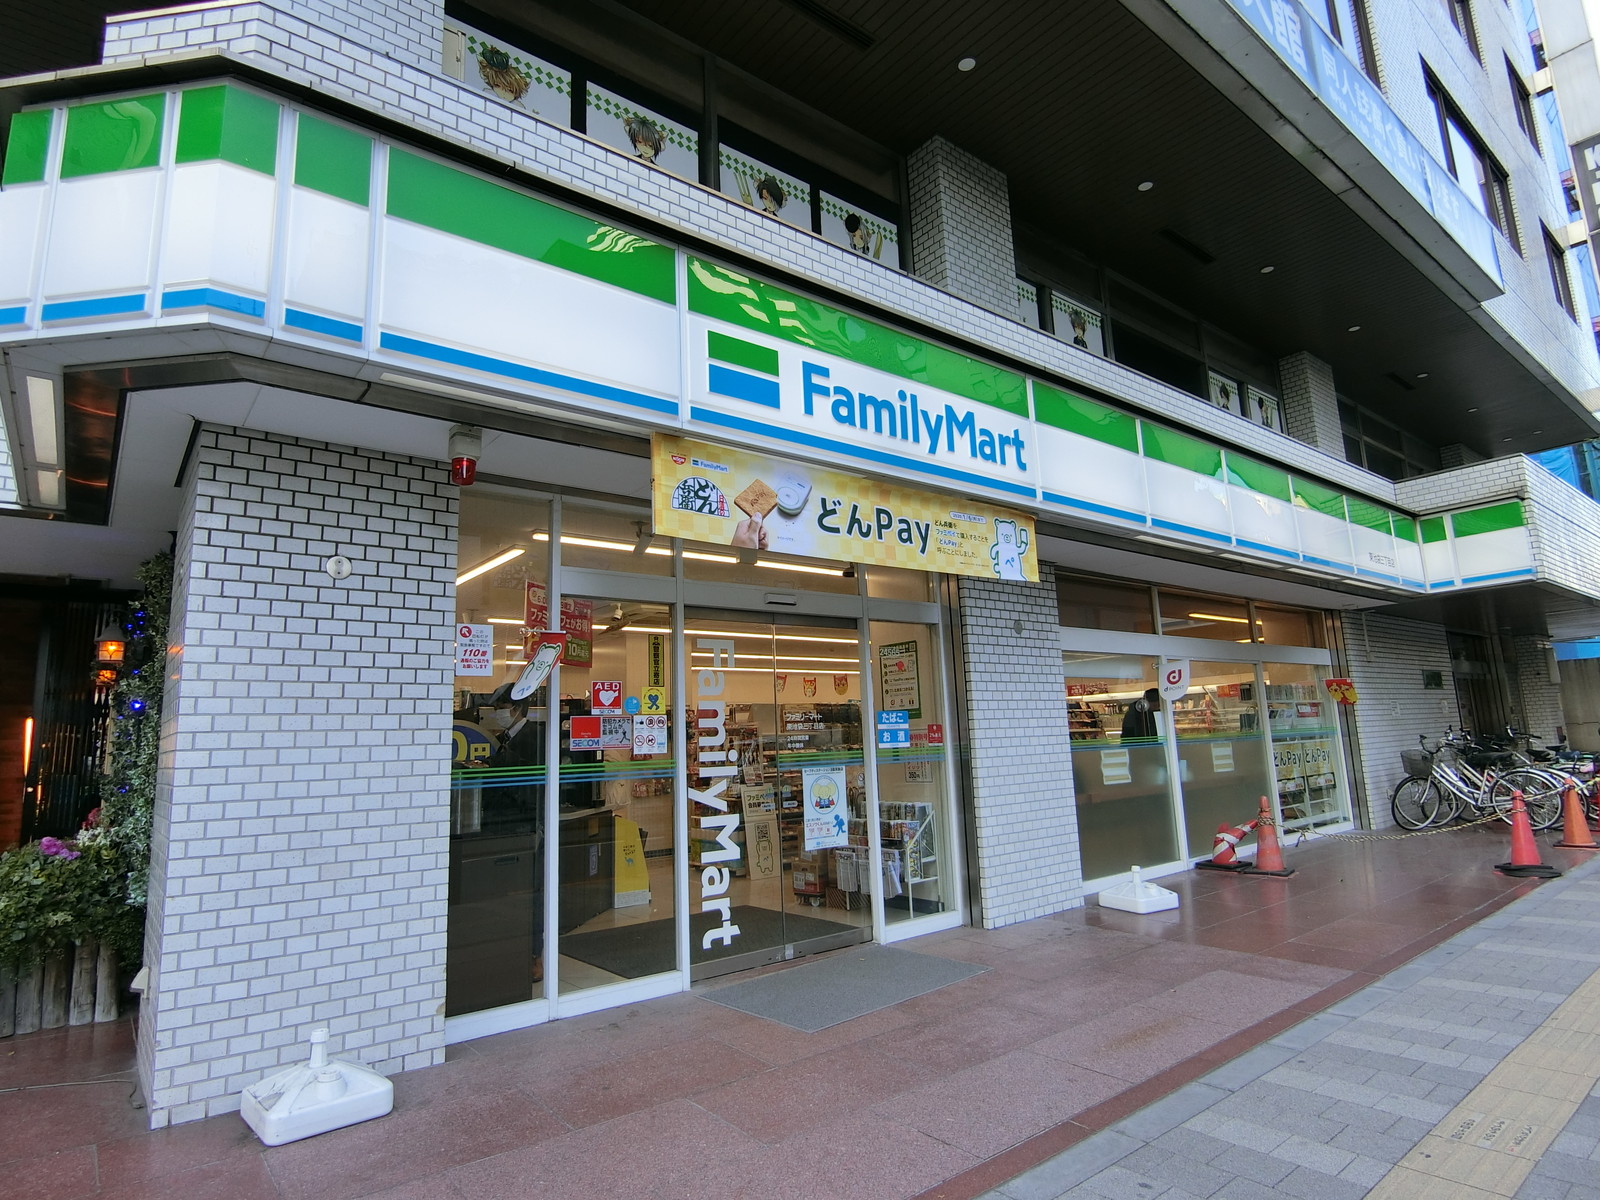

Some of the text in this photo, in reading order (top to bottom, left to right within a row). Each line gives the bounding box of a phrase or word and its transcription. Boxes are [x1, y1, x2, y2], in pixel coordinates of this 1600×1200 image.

[802, 360, 1027, 471] FamilyMart
[700, 461, 728, 472] FamilyMart
[817, 497, 930, 555] どんPay
[463, 648, 487, 657] 110番
[594, 682, 620, 690] AED
[786, 713, 823, 721] ファミリーマート
[881, 712, 904, 723] たばこ
[882, 730, 905, 742] お酒
[572, 739, 600, 748] SECOM
[1305, 747, 1330, 765] どんPay
[688, 639, 741, 950] FamilyMart
